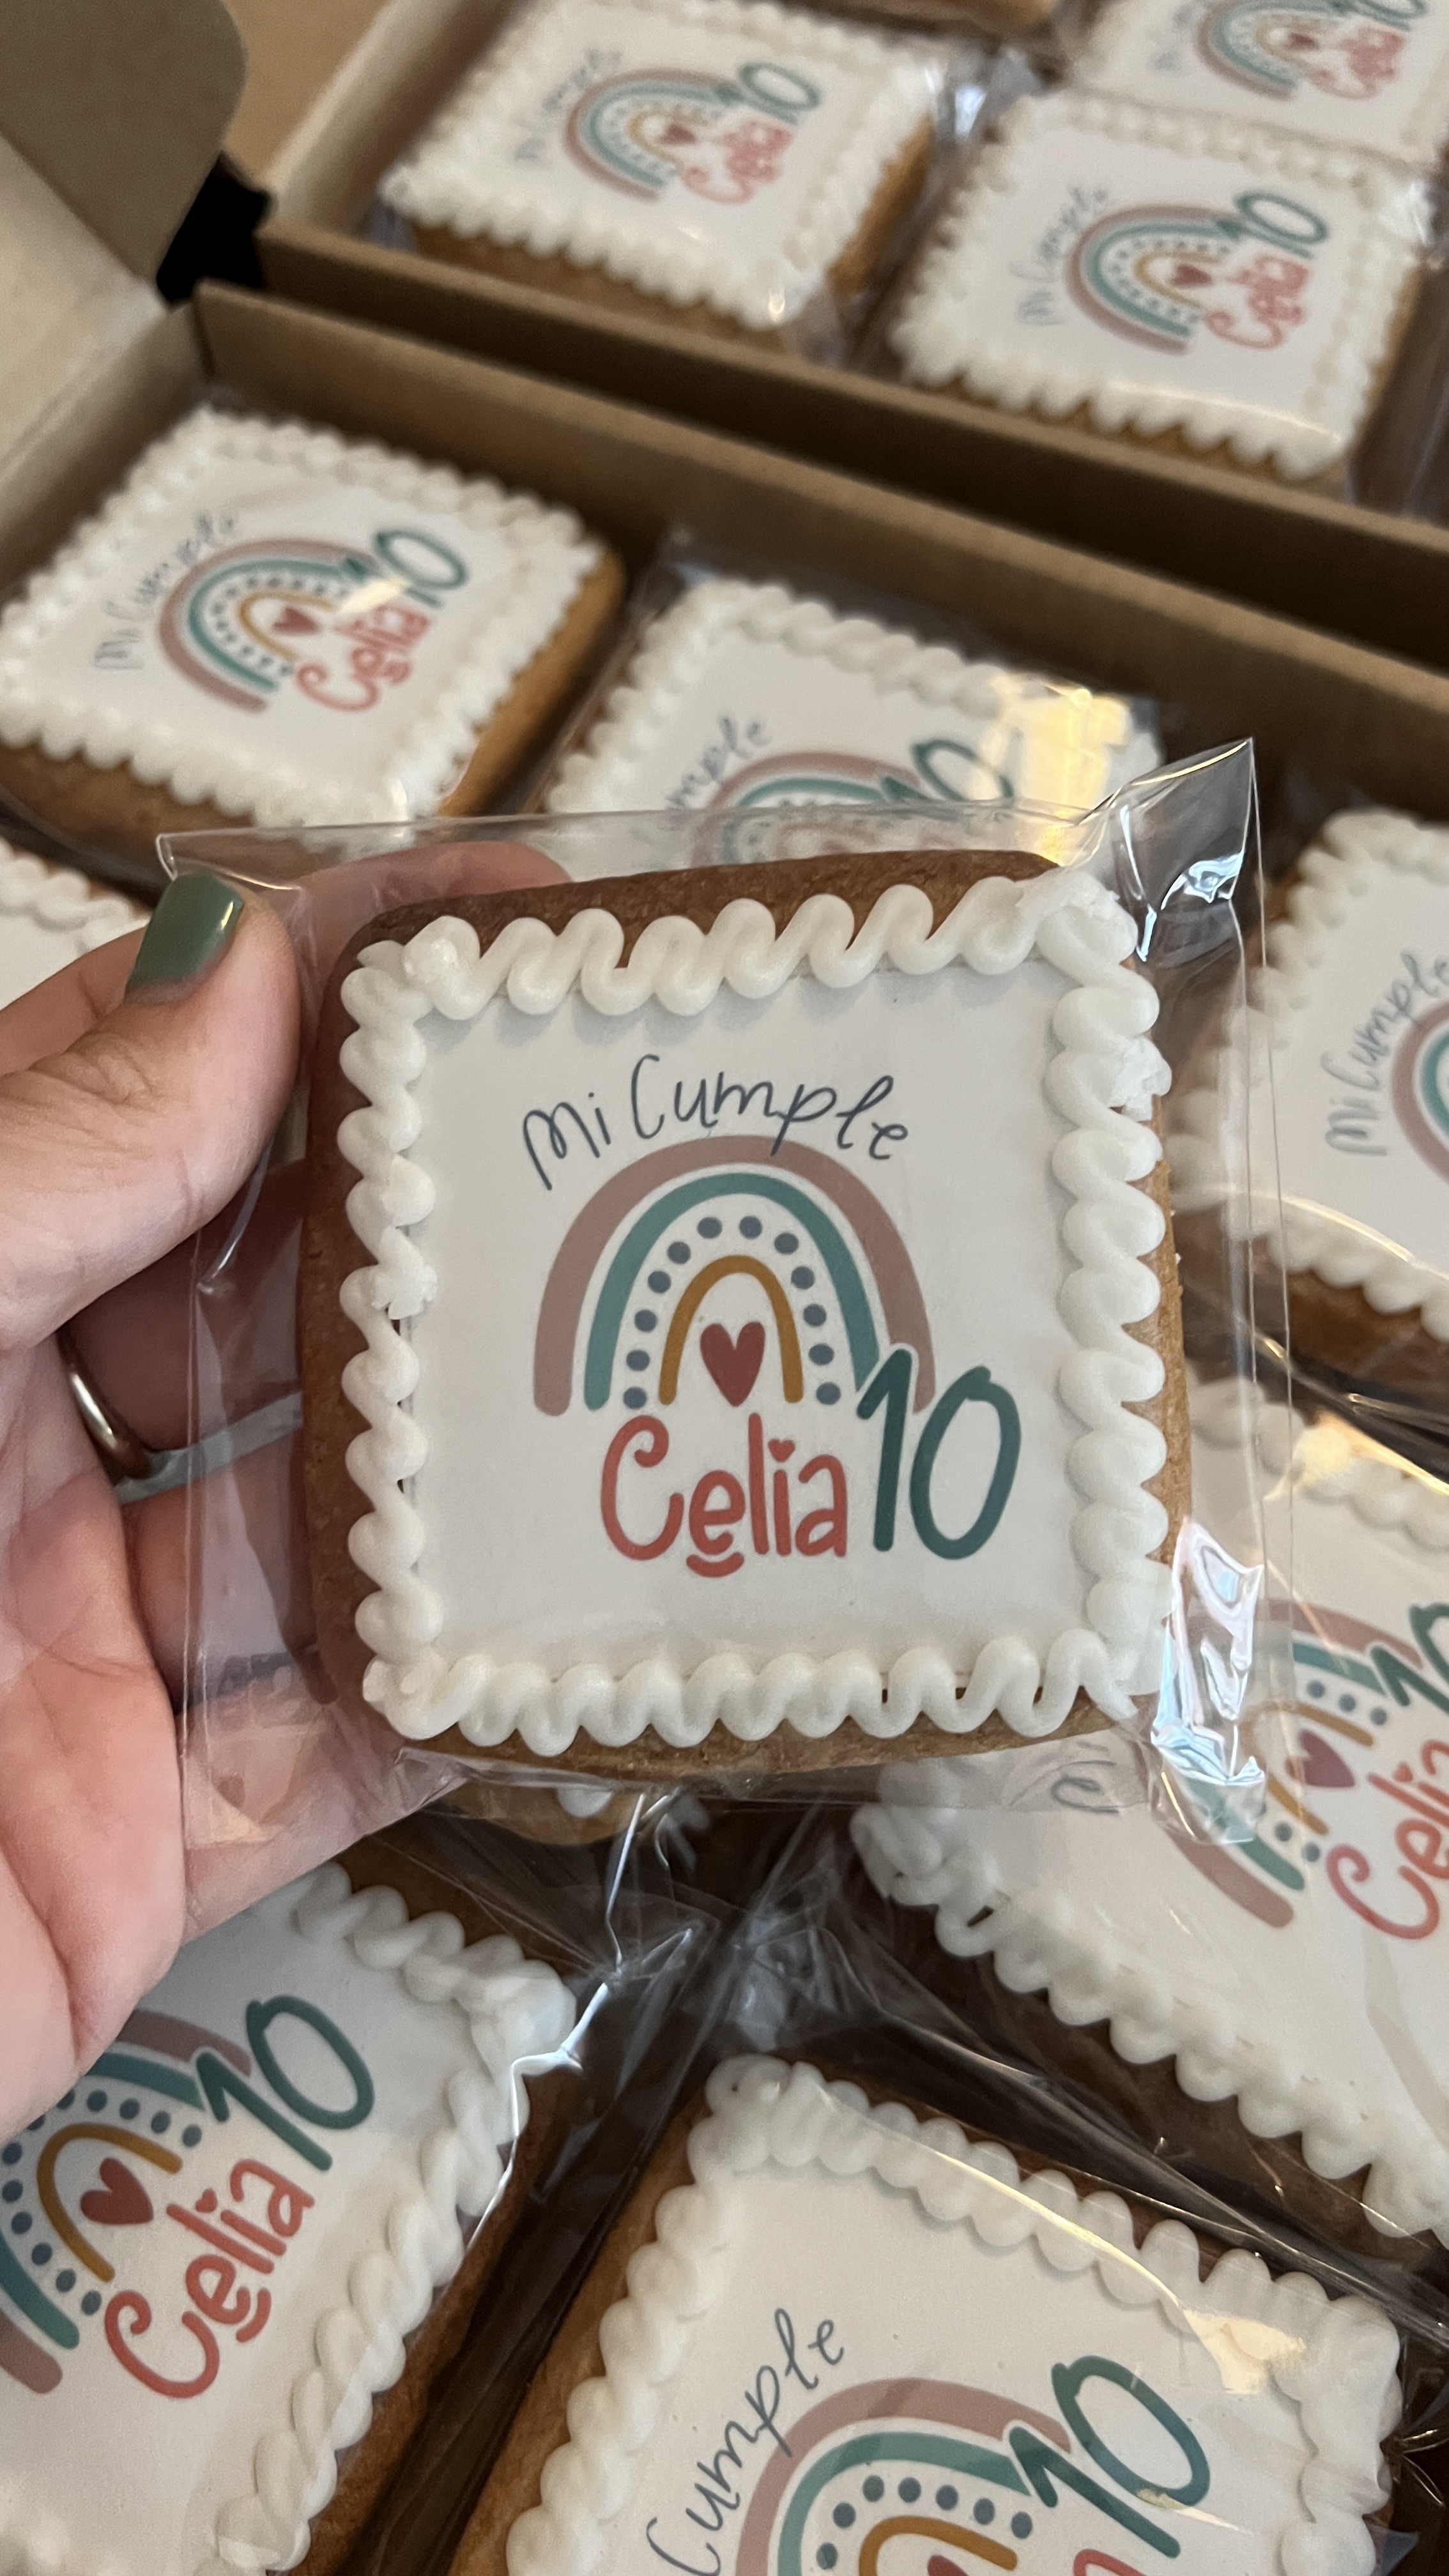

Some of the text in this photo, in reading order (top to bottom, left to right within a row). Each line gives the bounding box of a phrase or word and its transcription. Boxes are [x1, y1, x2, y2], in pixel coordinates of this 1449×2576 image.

[1215, 190, 1330, 259] 10
[339, 529, 470, 610] 10
[521, 1053, 909, 1191] Mi Cumple
[600, 1347, 1022, 1578] Celia 10
[195, 1995, 375, 2172] 10
[104, 2158, 315, 2399] Celia
[645, 2307, 845, 2576] Cumple
[1008, 2354, 1211, 2559] 10
